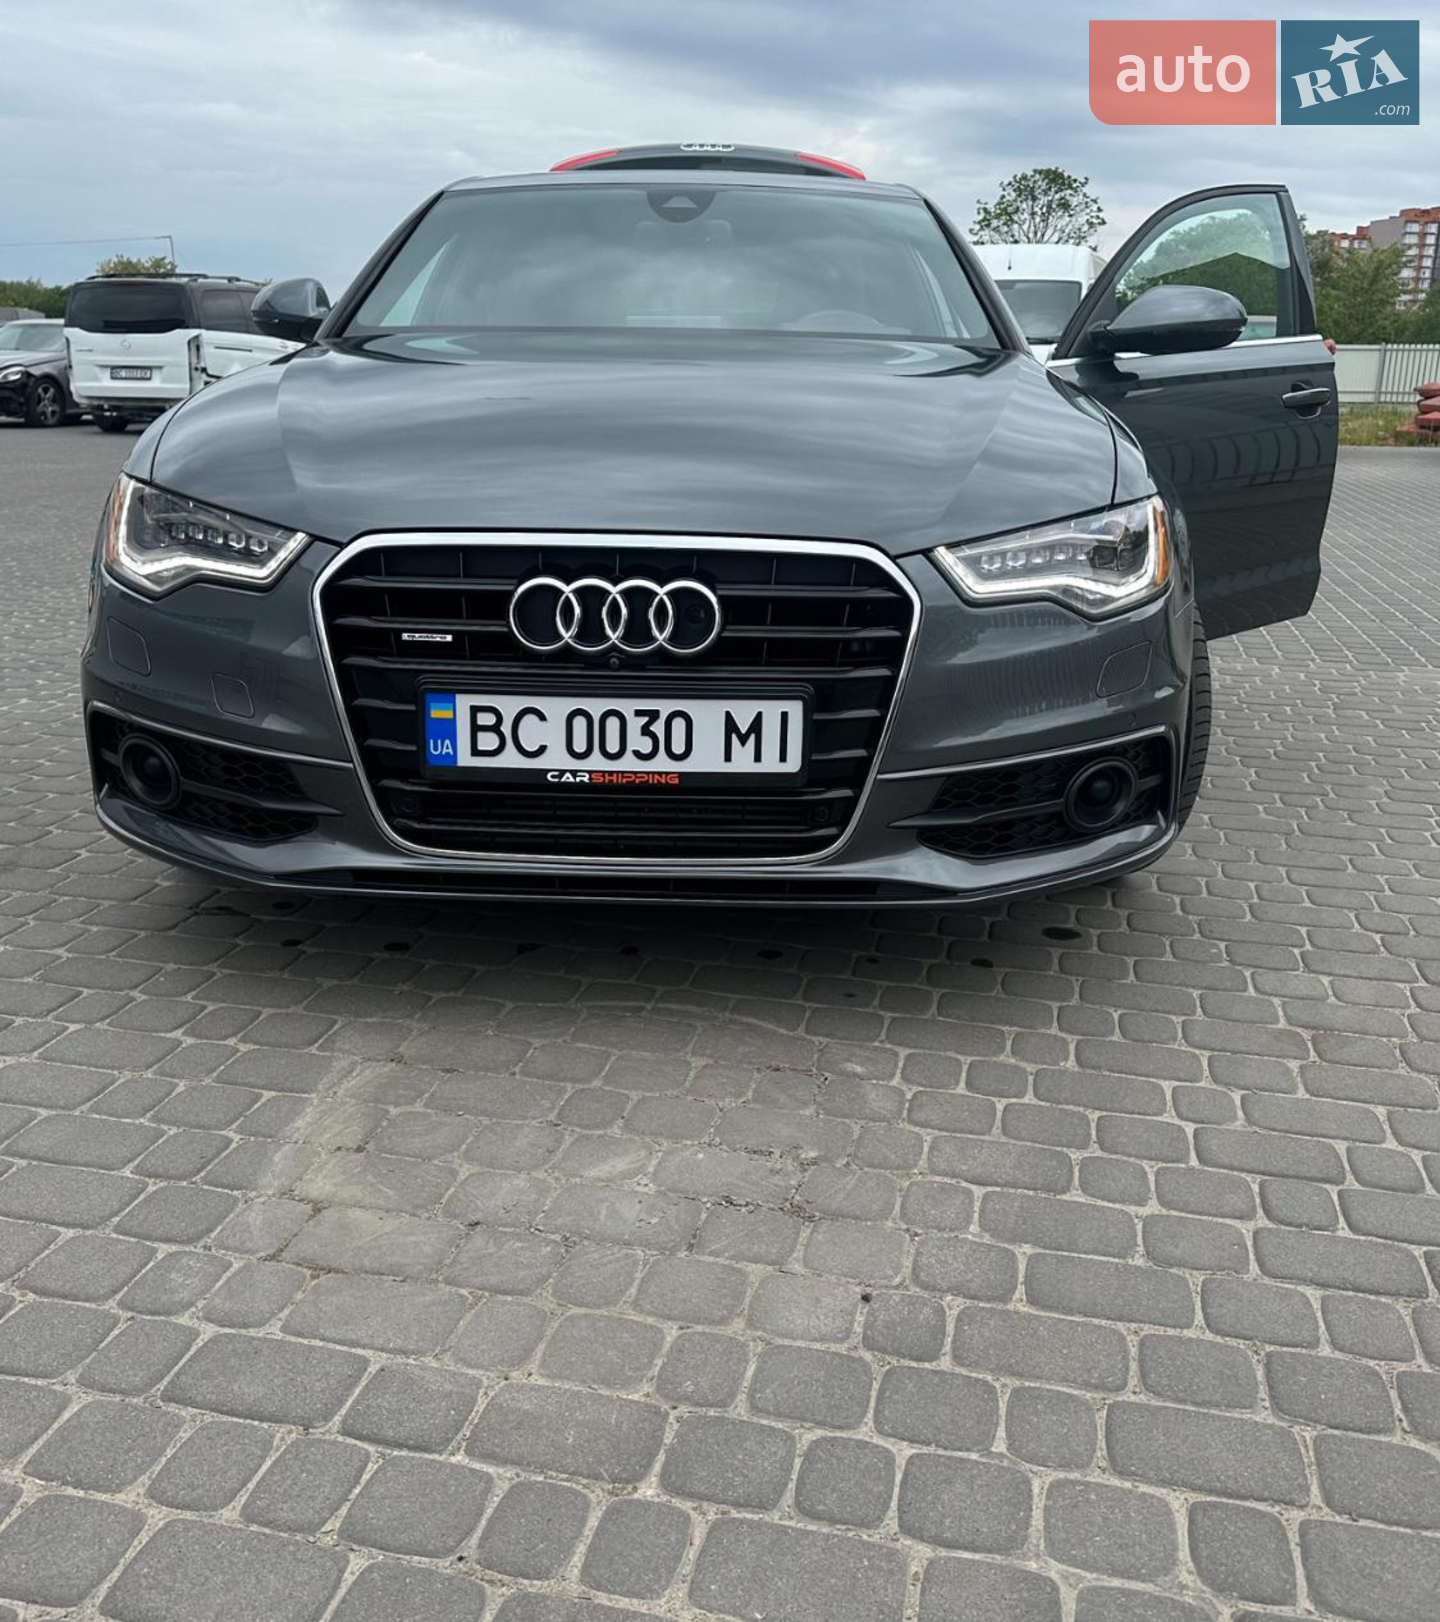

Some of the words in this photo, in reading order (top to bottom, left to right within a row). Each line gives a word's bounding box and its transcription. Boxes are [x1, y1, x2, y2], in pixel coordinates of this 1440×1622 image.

[429, 739, 454, 756] UA
[469, 704, 548, 759] BC
[565, 707, 693, 761] 0030
[724, 710, 789, 763] MI
